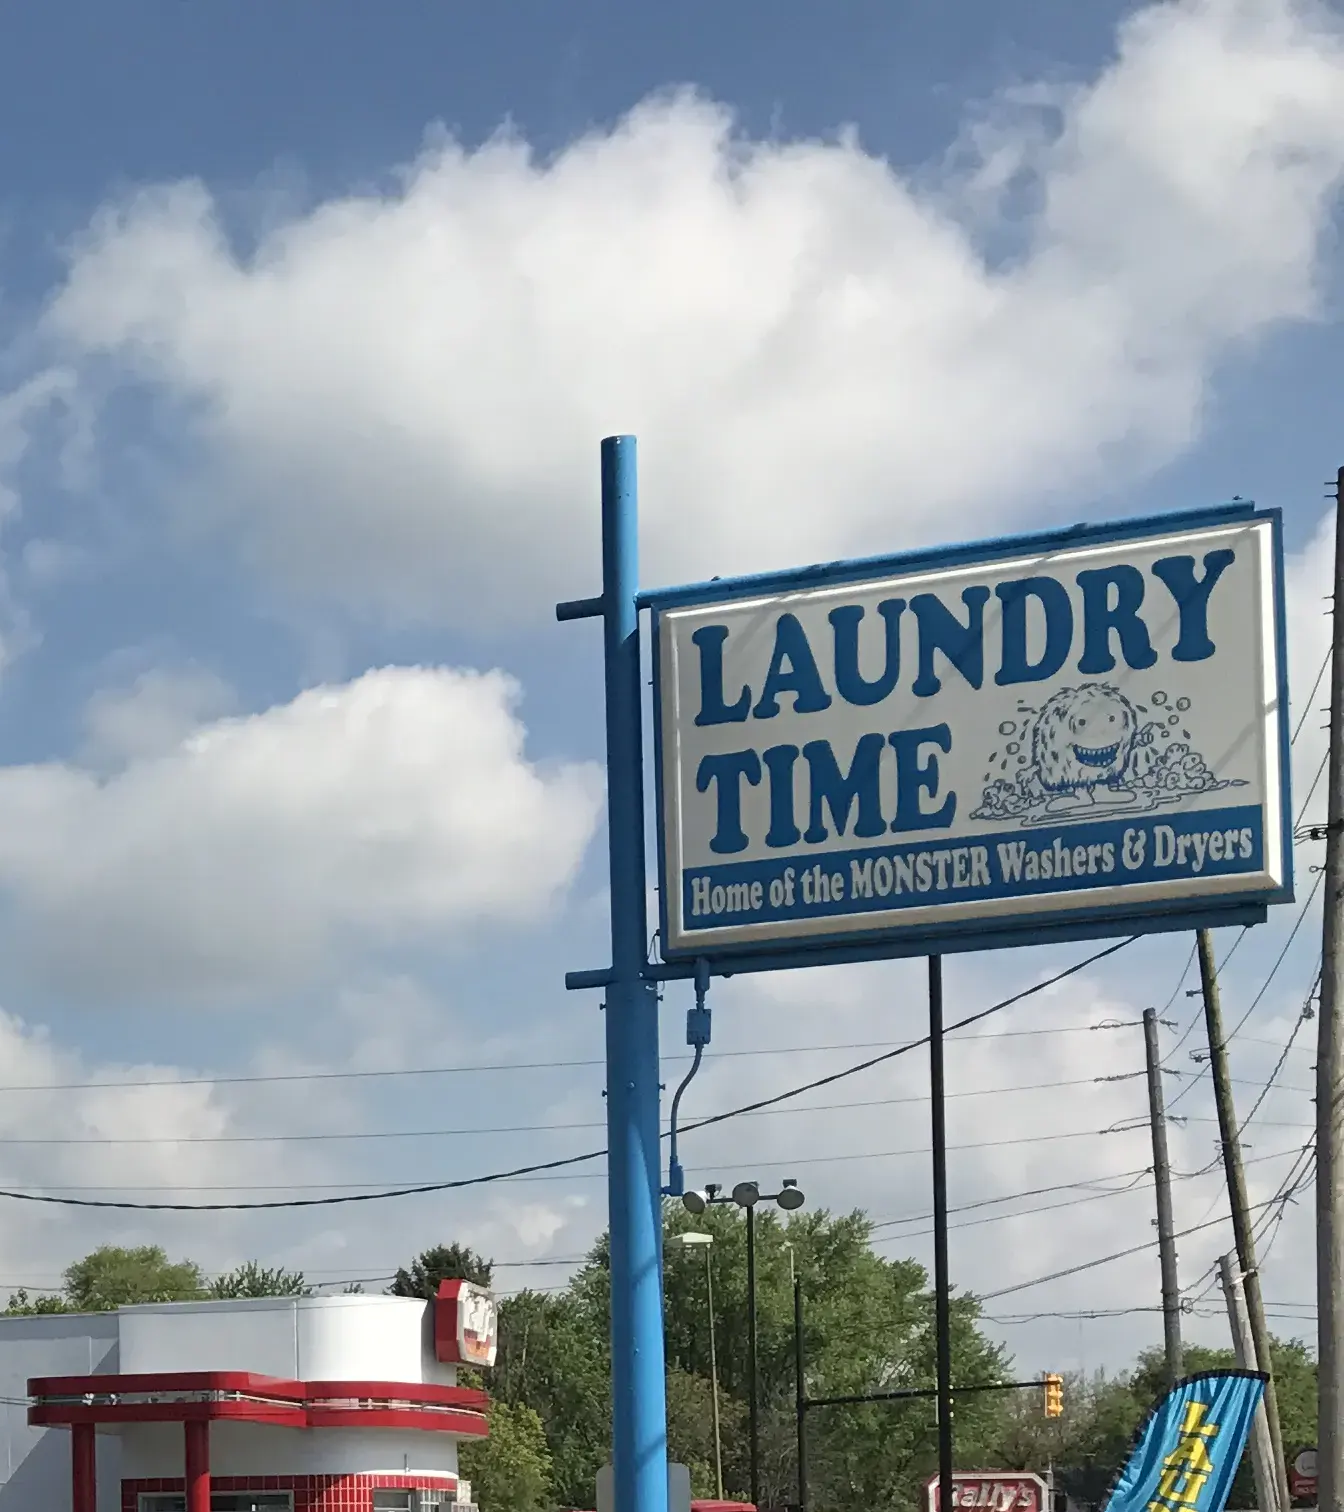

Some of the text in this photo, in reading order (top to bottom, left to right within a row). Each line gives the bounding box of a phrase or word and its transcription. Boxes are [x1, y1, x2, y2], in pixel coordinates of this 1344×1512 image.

[691, 549, 1235, 727] LAUNDRY
[696, 723, 957, 854] TIME
[691, 823, 1253, 917] Home of the MONSTER Washers & Dryers
